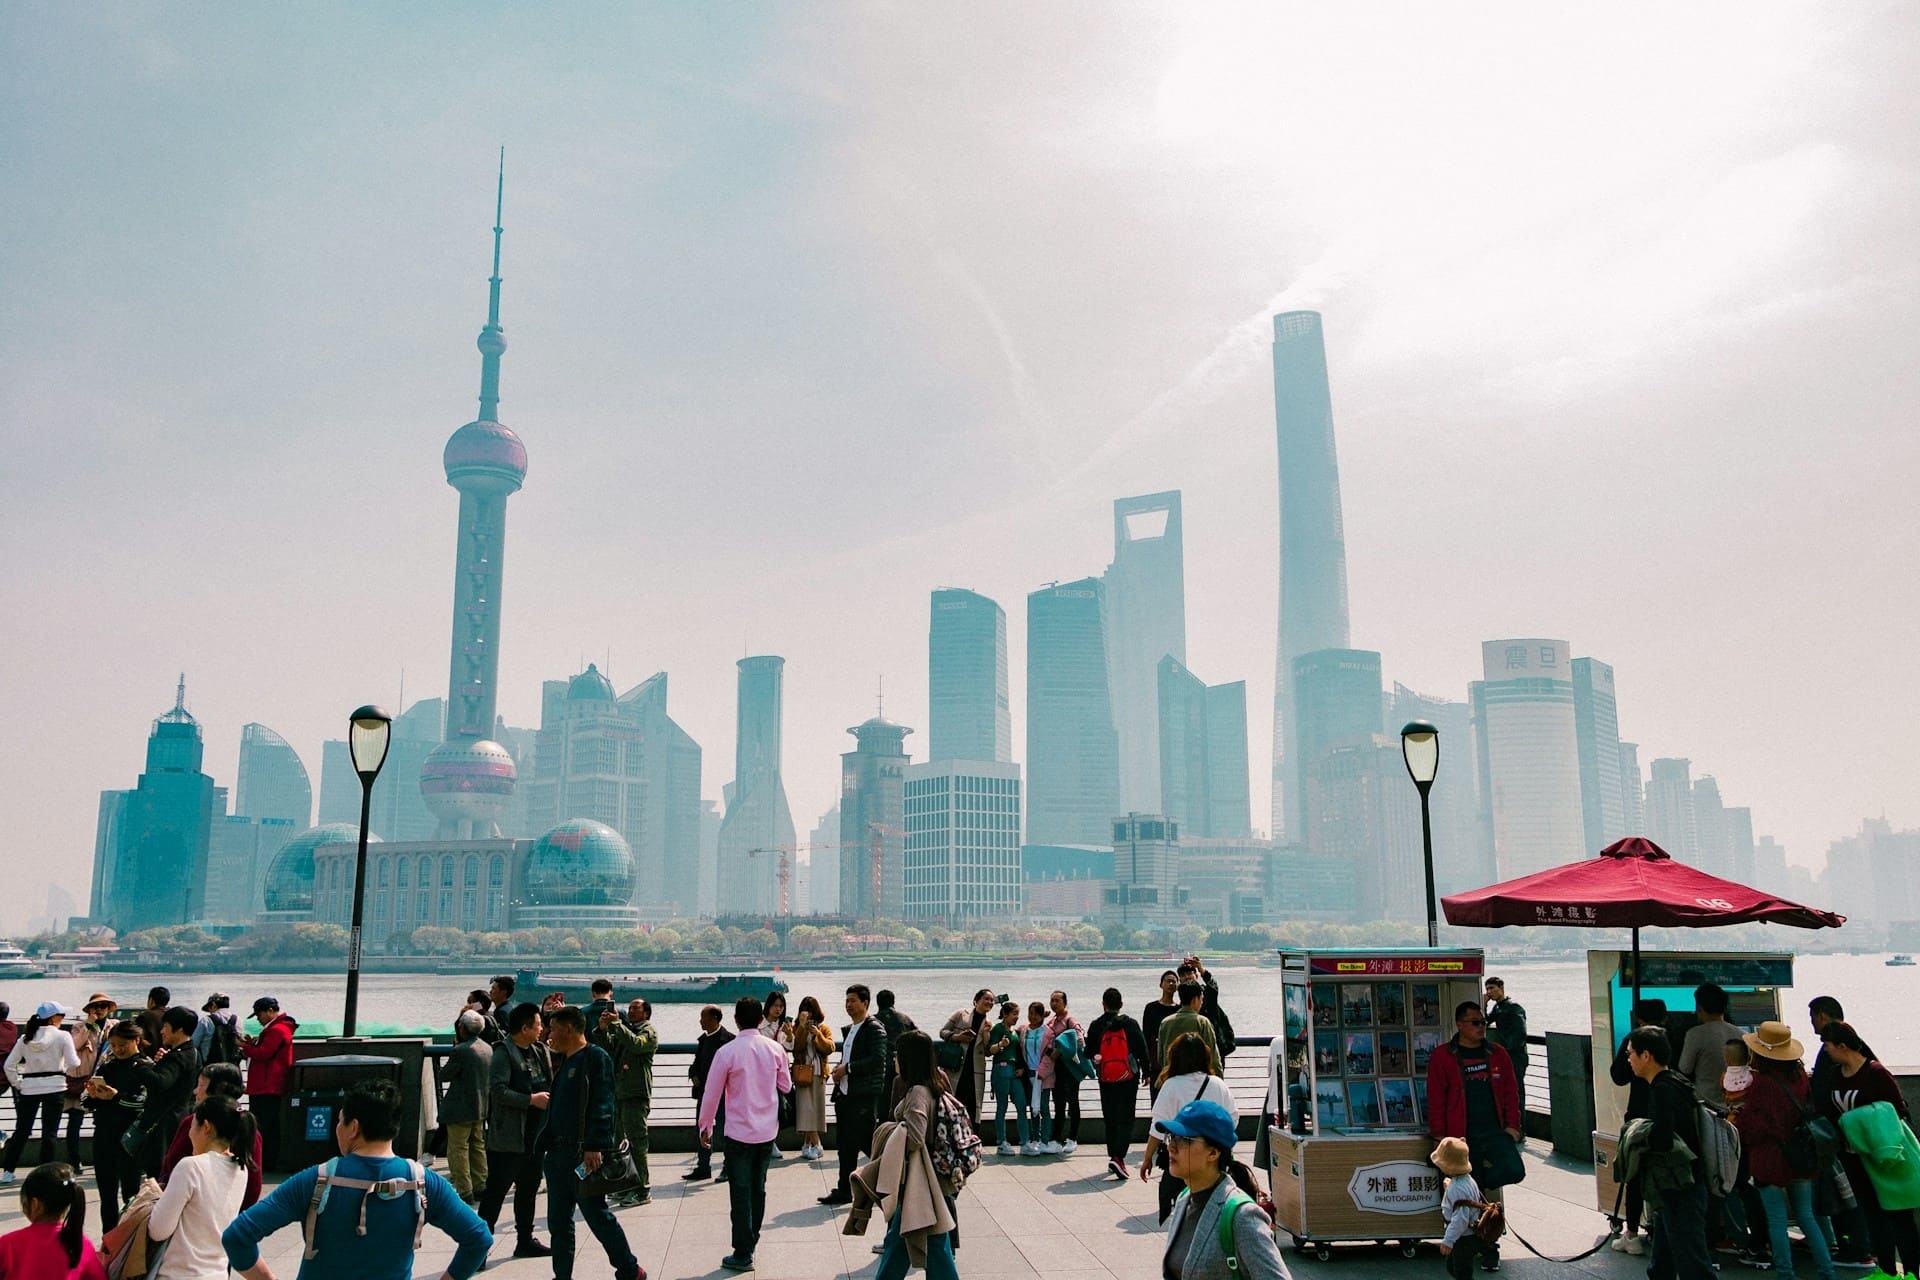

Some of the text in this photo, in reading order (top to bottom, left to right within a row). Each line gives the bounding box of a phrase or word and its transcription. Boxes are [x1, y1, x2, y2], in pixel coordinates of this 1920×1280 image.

[1505, 646, 1557, 669] 震旦
[1695, 898, 1733, 909] 06
[1368, 960, 1427, 973] 外滩 摄影
[1367, 1176, 1440, 1193] 外滩 摄影
[1374, 1194, 1433, 1203] PHOTOGRAPHY
